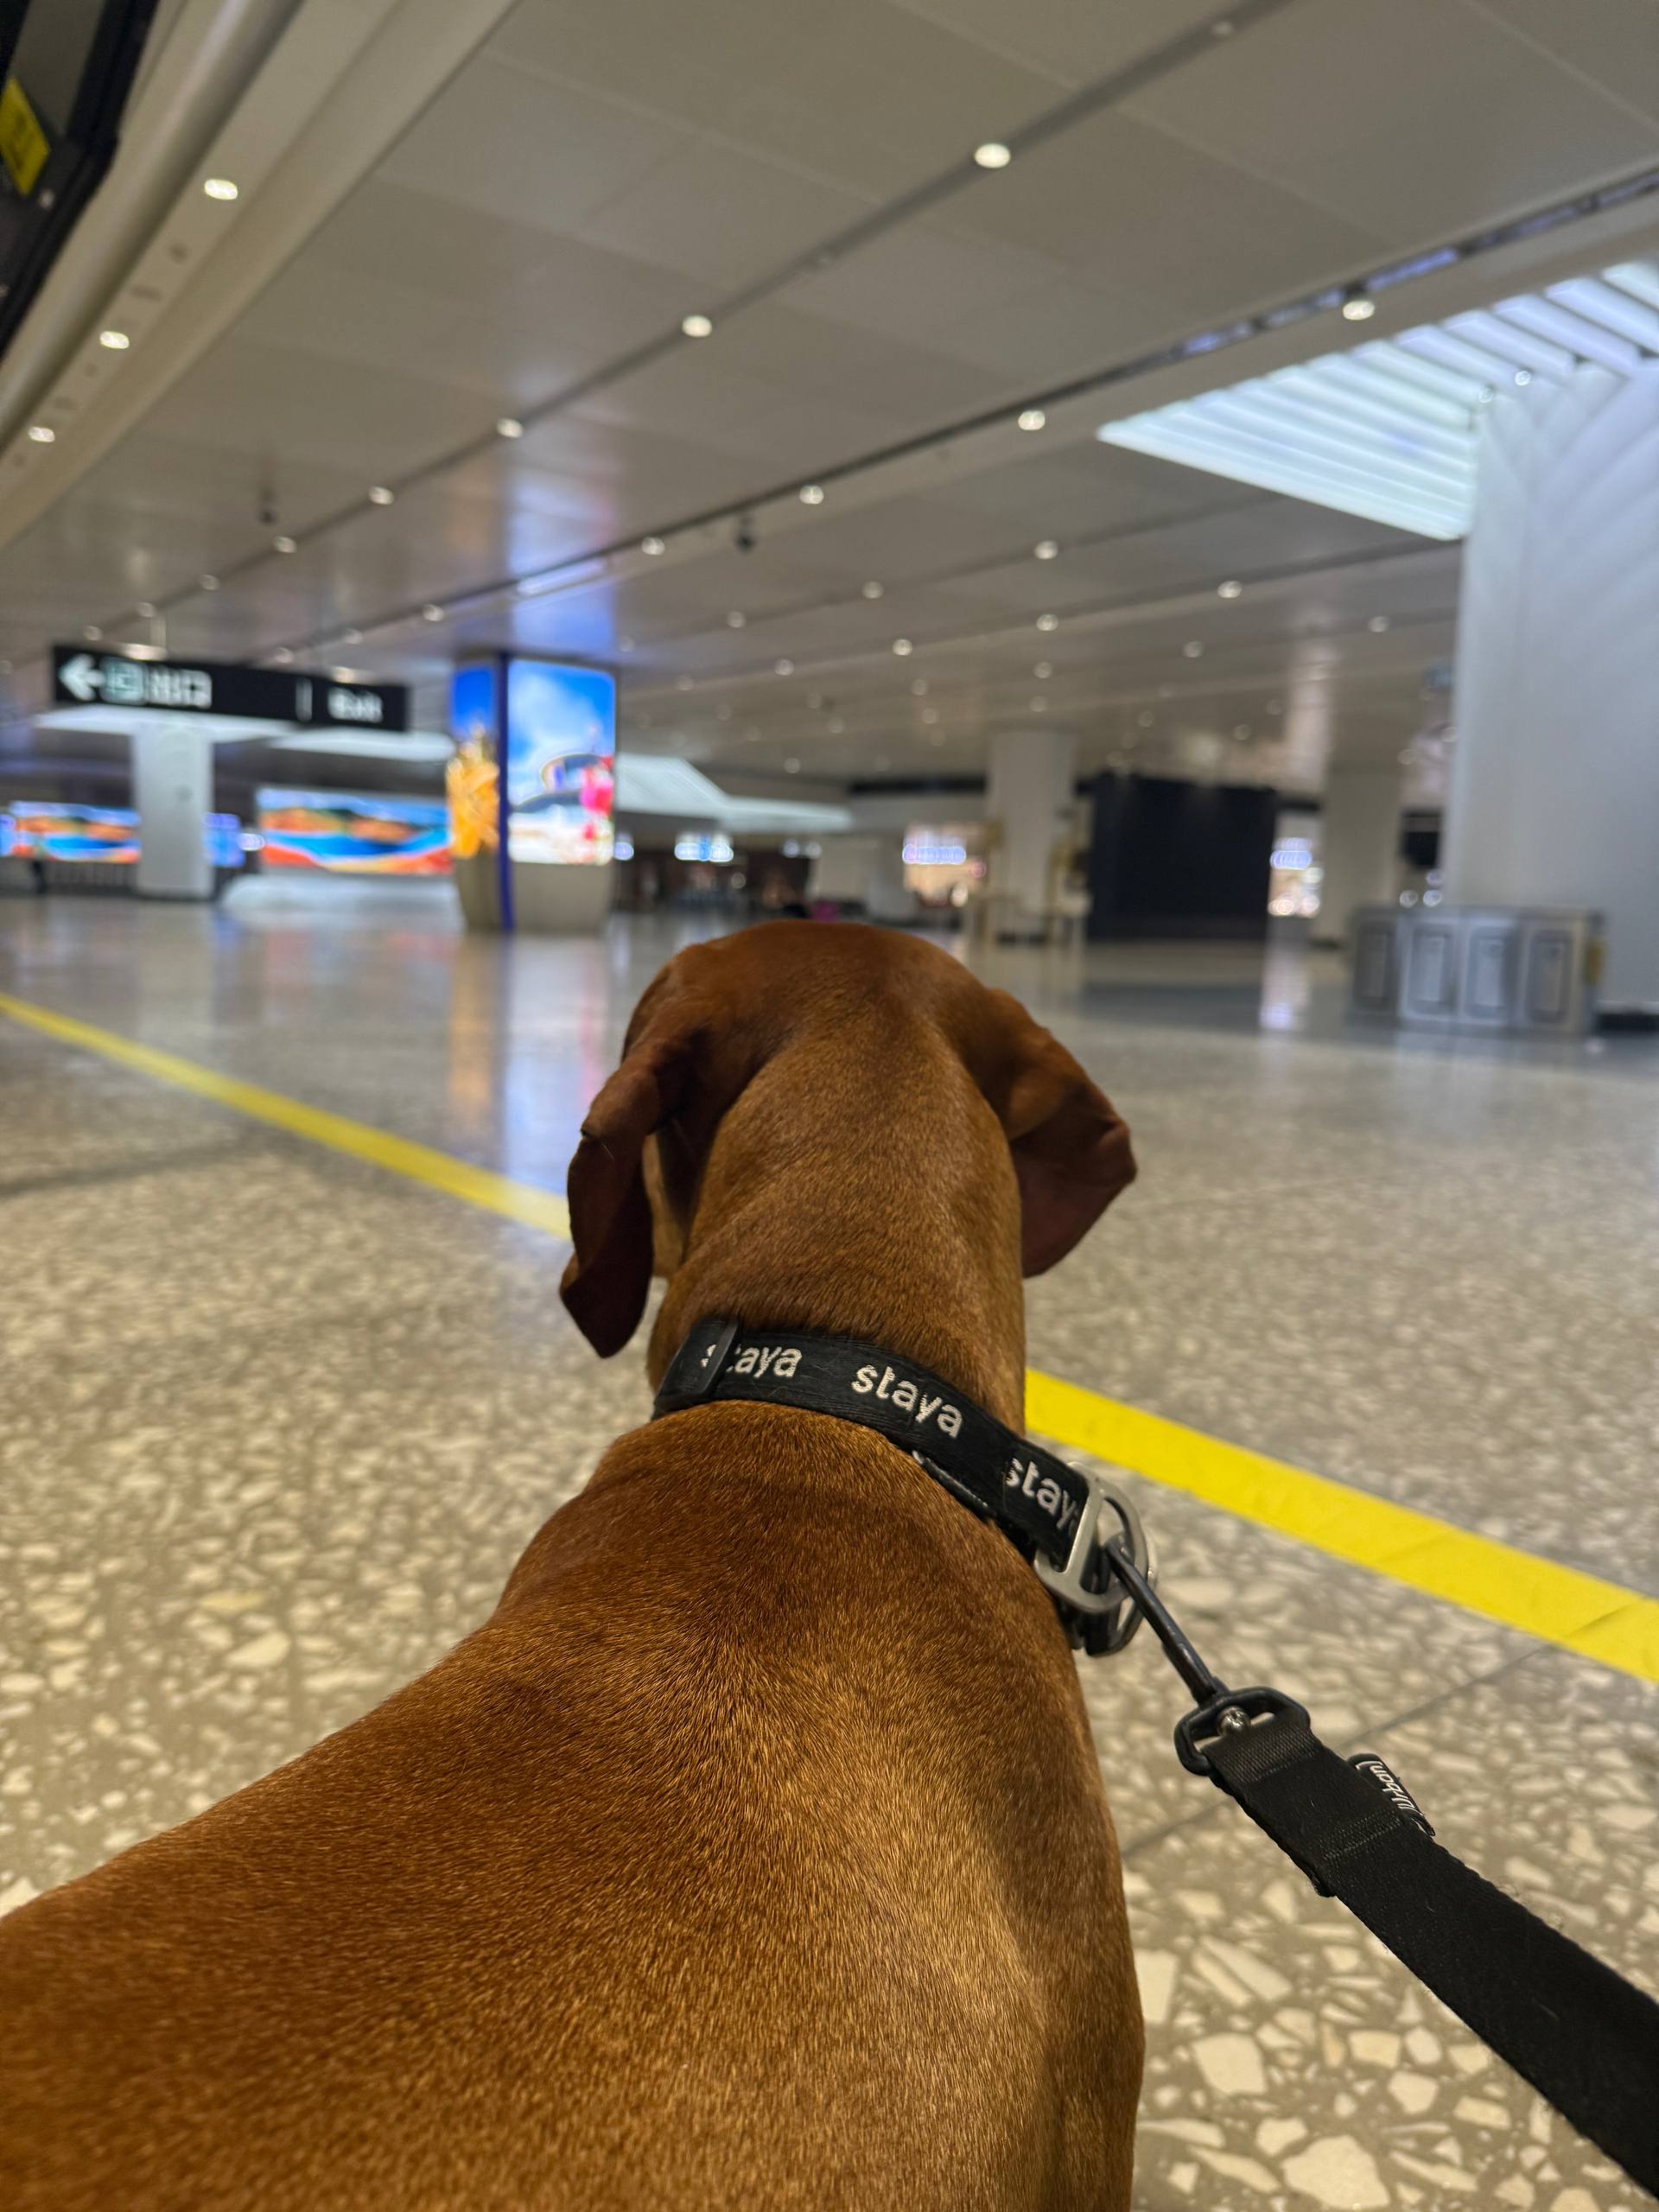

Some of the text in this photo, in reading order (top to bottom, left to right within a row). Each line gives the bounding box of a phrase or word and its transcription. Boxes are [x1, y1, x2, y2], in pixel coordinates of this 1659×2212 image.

[699, 1344, 803, 1378] aya
[851, 1364, 963, 1438] staya
[1005, 1458, 1079, 1530] stay
